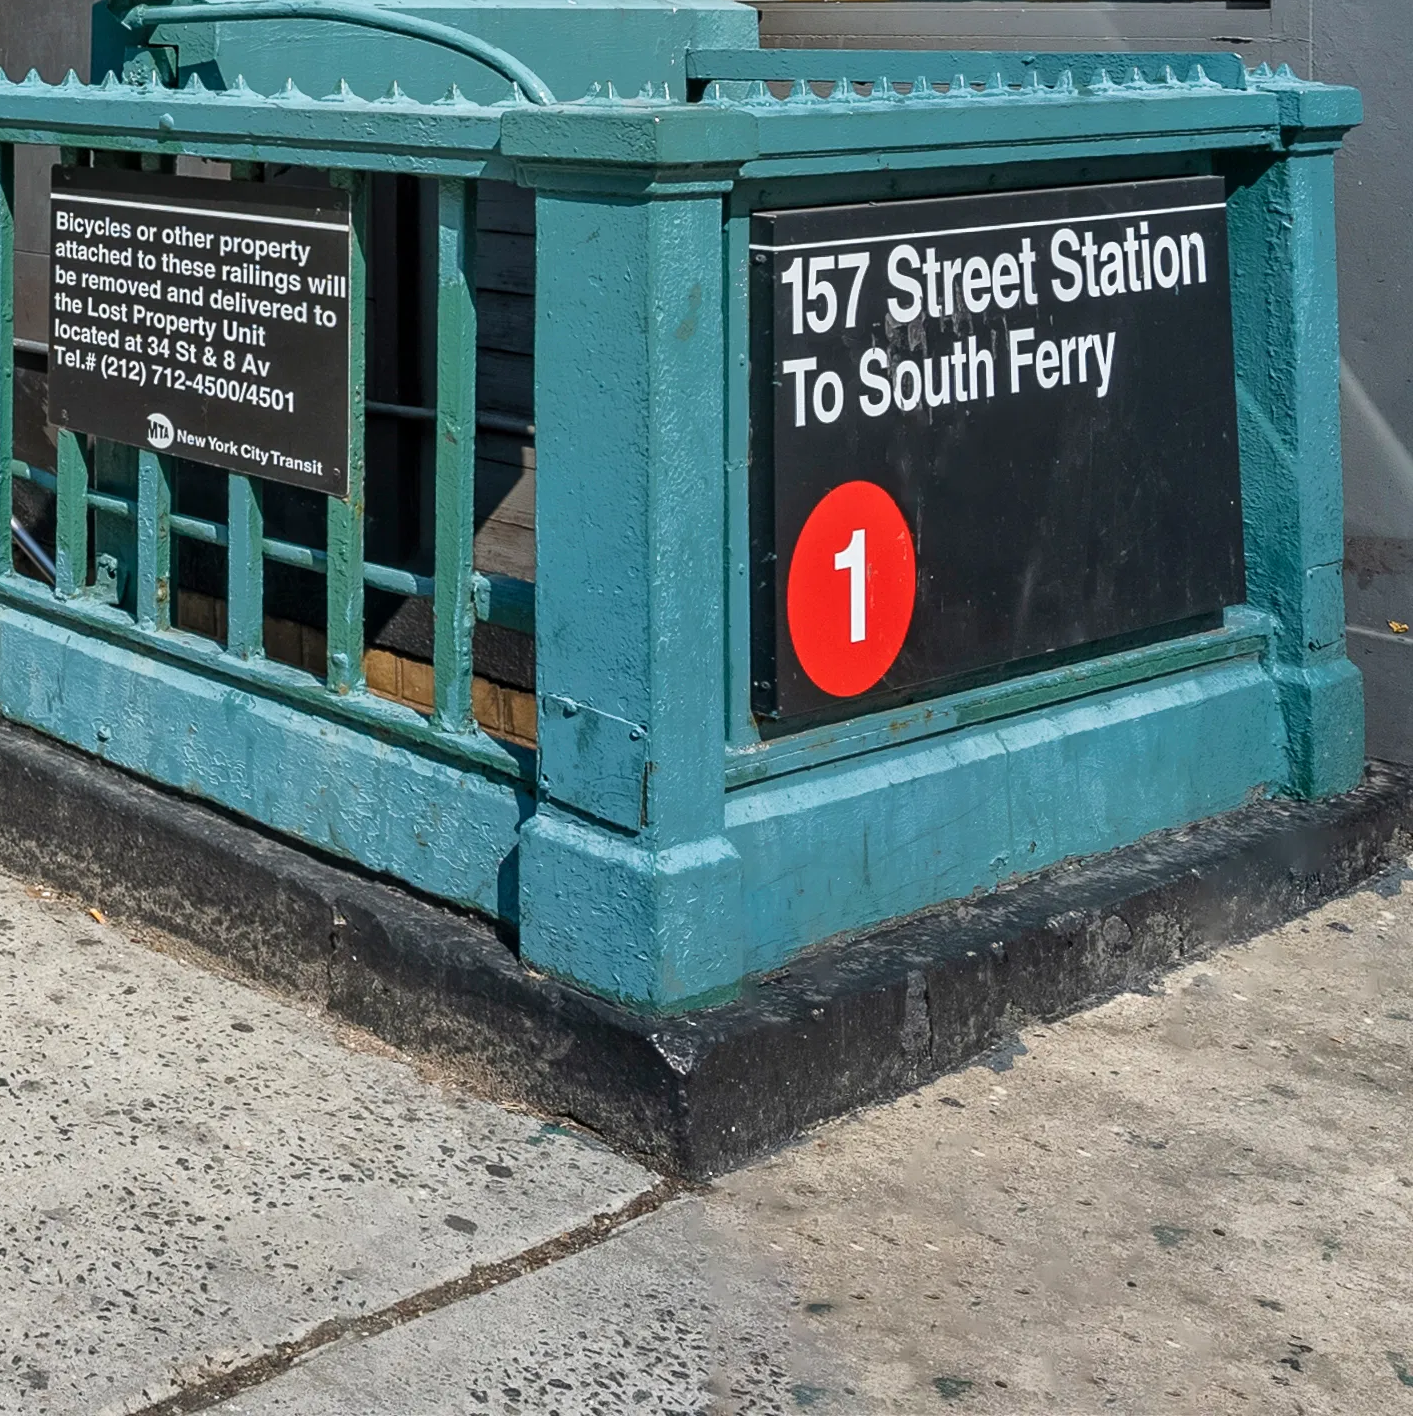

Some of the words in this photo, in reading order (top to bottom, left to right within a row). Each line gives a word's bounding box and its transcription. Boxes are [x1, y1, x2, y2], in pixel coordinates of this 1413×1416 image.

[56, 211, 131, 239] Bicycles
[137, 225, 157, 242] or
[162, 225, 214, 249] other
[220, 234, 311, 267] property
[56, 240, 132, 267] attached
[138, 253, 156, 270] to
[162, 254, 216, 279] these
[222, 264, 301, 294] railings
[308, 275, 346, 298] will
[56, 265, 76, 286] be
[82, 271, 161, 300] removed
[167, 285, 204, 307] and
[210, 293, 308, 323] delivered
[313, 307, 337, 328] to
[781, 251, 871, 335] 157
[887, 238, 1039, 324] Street
[1050, 221, 1208, 302] Station
[55, 292, 82, 314] the
[87, 297, 128, 323] Lost
[133, 305, 216, 342] Property
[223, 320, 266, 347] Unit
[55, 319, 119, 348] located
[125, 335, 142, 354] at
[148, 337, 170, 358] 34
[175, 341, 197, 365] St
[203, 346, 218, 368] &
[223, 350, 236, 371] 8
[242, 353, 271, 378] Av
[54, 345, 97, 371] Tel.#
[101, 354, 147, 386] (212)
[151, 365, 295, 413] 712-4500/4501
[783, 357, 844, 428] To
[859, 336, 995, 418] South
[1009, 328, 1117, 398] Ferry
[147, 418, 172, 444] MTA
[177, 429, 205, 449] New
[208, 436, 238, 457] York
[241, 444, 269, 466] City
[270, 450, 323, 476] Transit
[834, 529, 866, 644] 1
